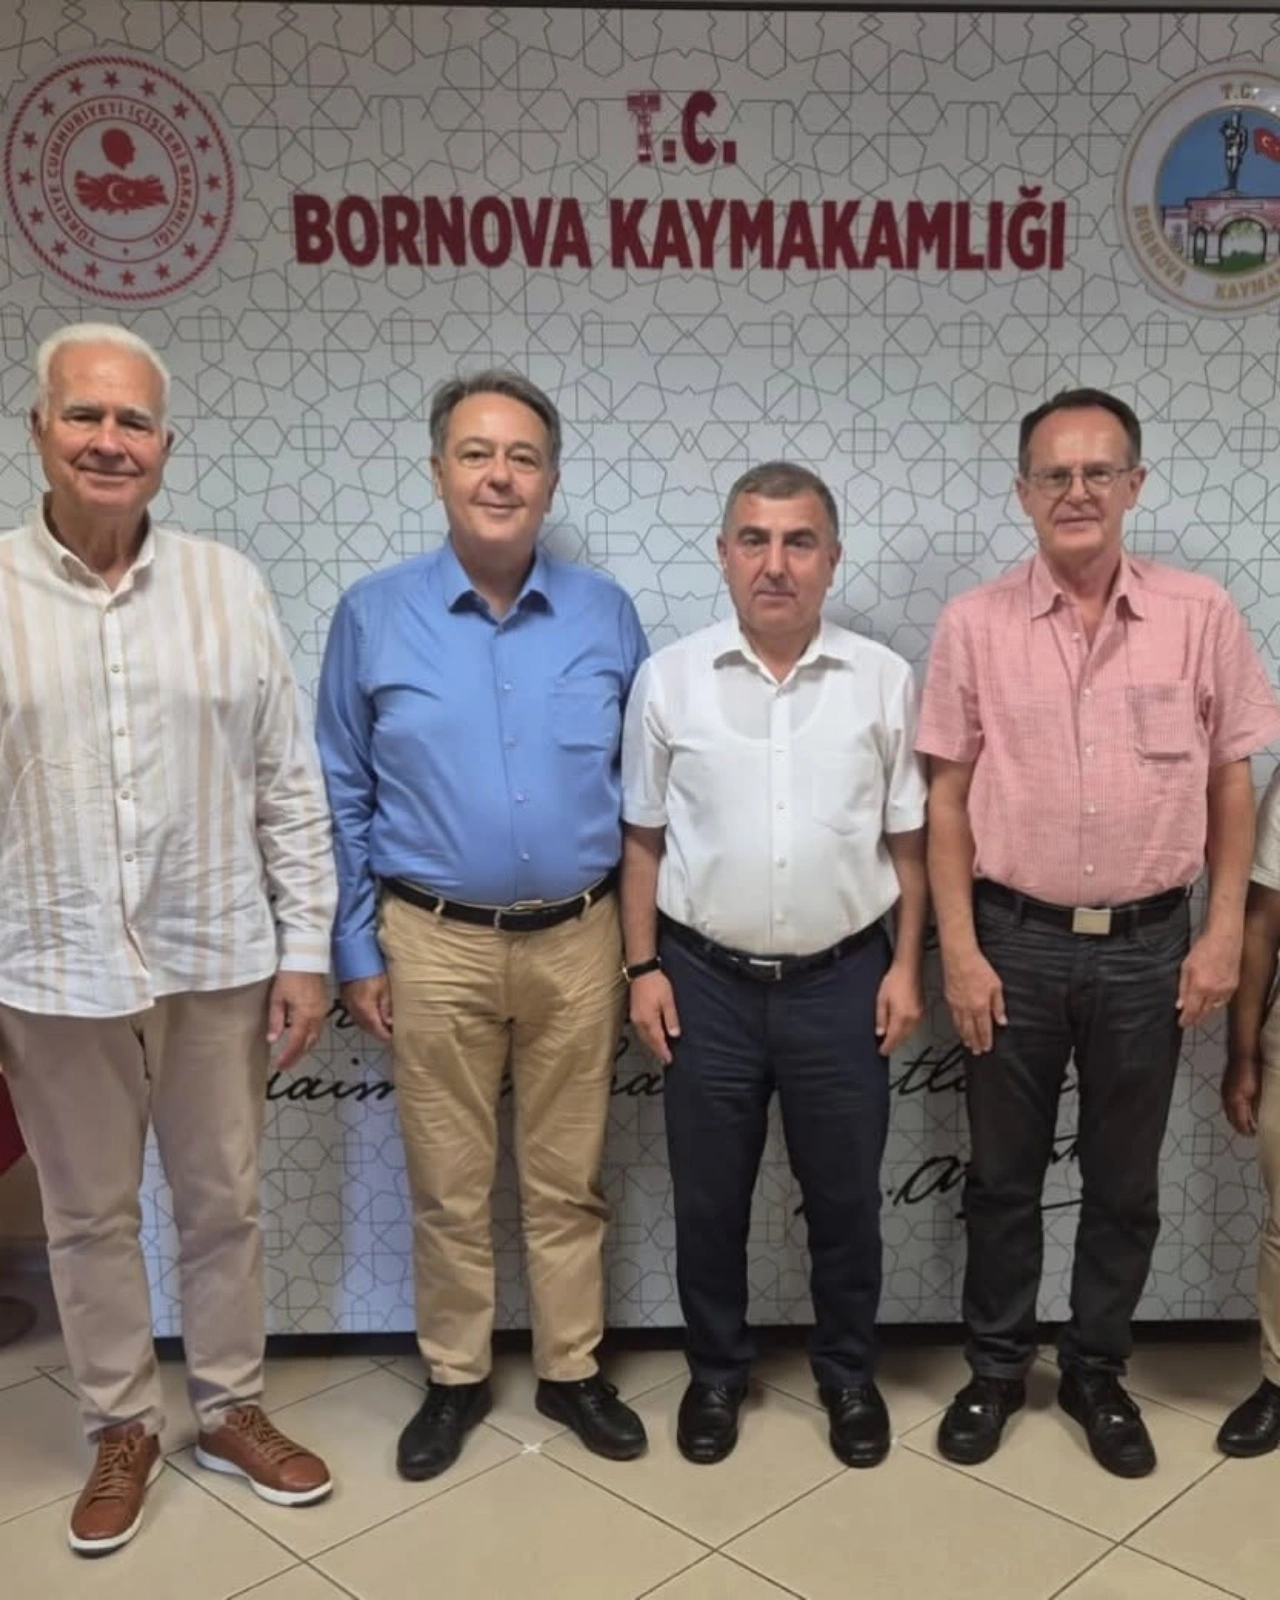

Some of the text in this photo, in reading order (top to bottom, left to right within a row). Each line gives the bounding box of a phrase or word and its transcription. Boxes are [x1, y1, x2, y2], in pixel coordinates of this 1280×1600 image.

[626, 89, 737, 165] T.C.
[293, 185, 1066, 271] BORNOVA KAYMAKAMLIĞI
[1133, 204, 1280, 300] BORNOVA KAYMA
